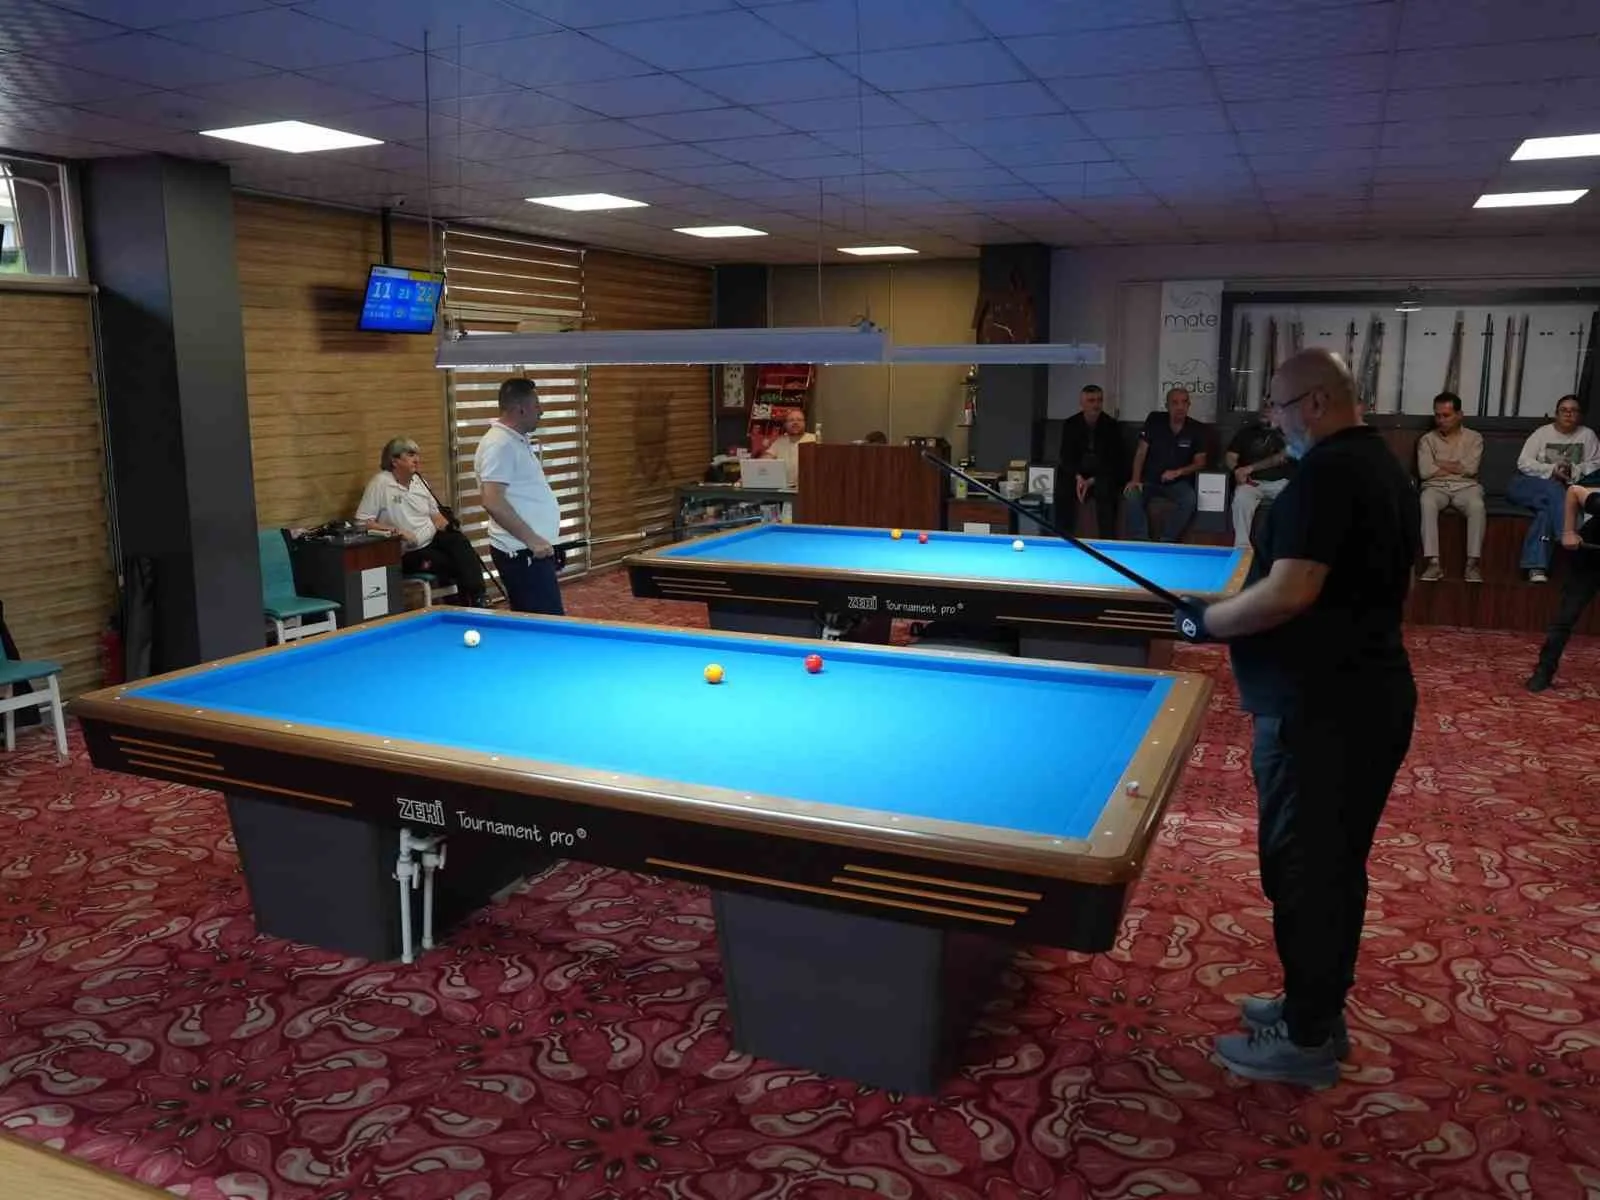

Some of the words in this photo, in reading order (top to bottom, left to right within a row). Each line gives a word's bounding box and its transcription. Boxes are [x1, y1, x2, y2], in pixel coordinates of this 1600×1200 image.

[1164, 312, 1218, 327] mate
[886, 599, 937, 614] Tournament
[456, 810, 543, 842] Tournament
